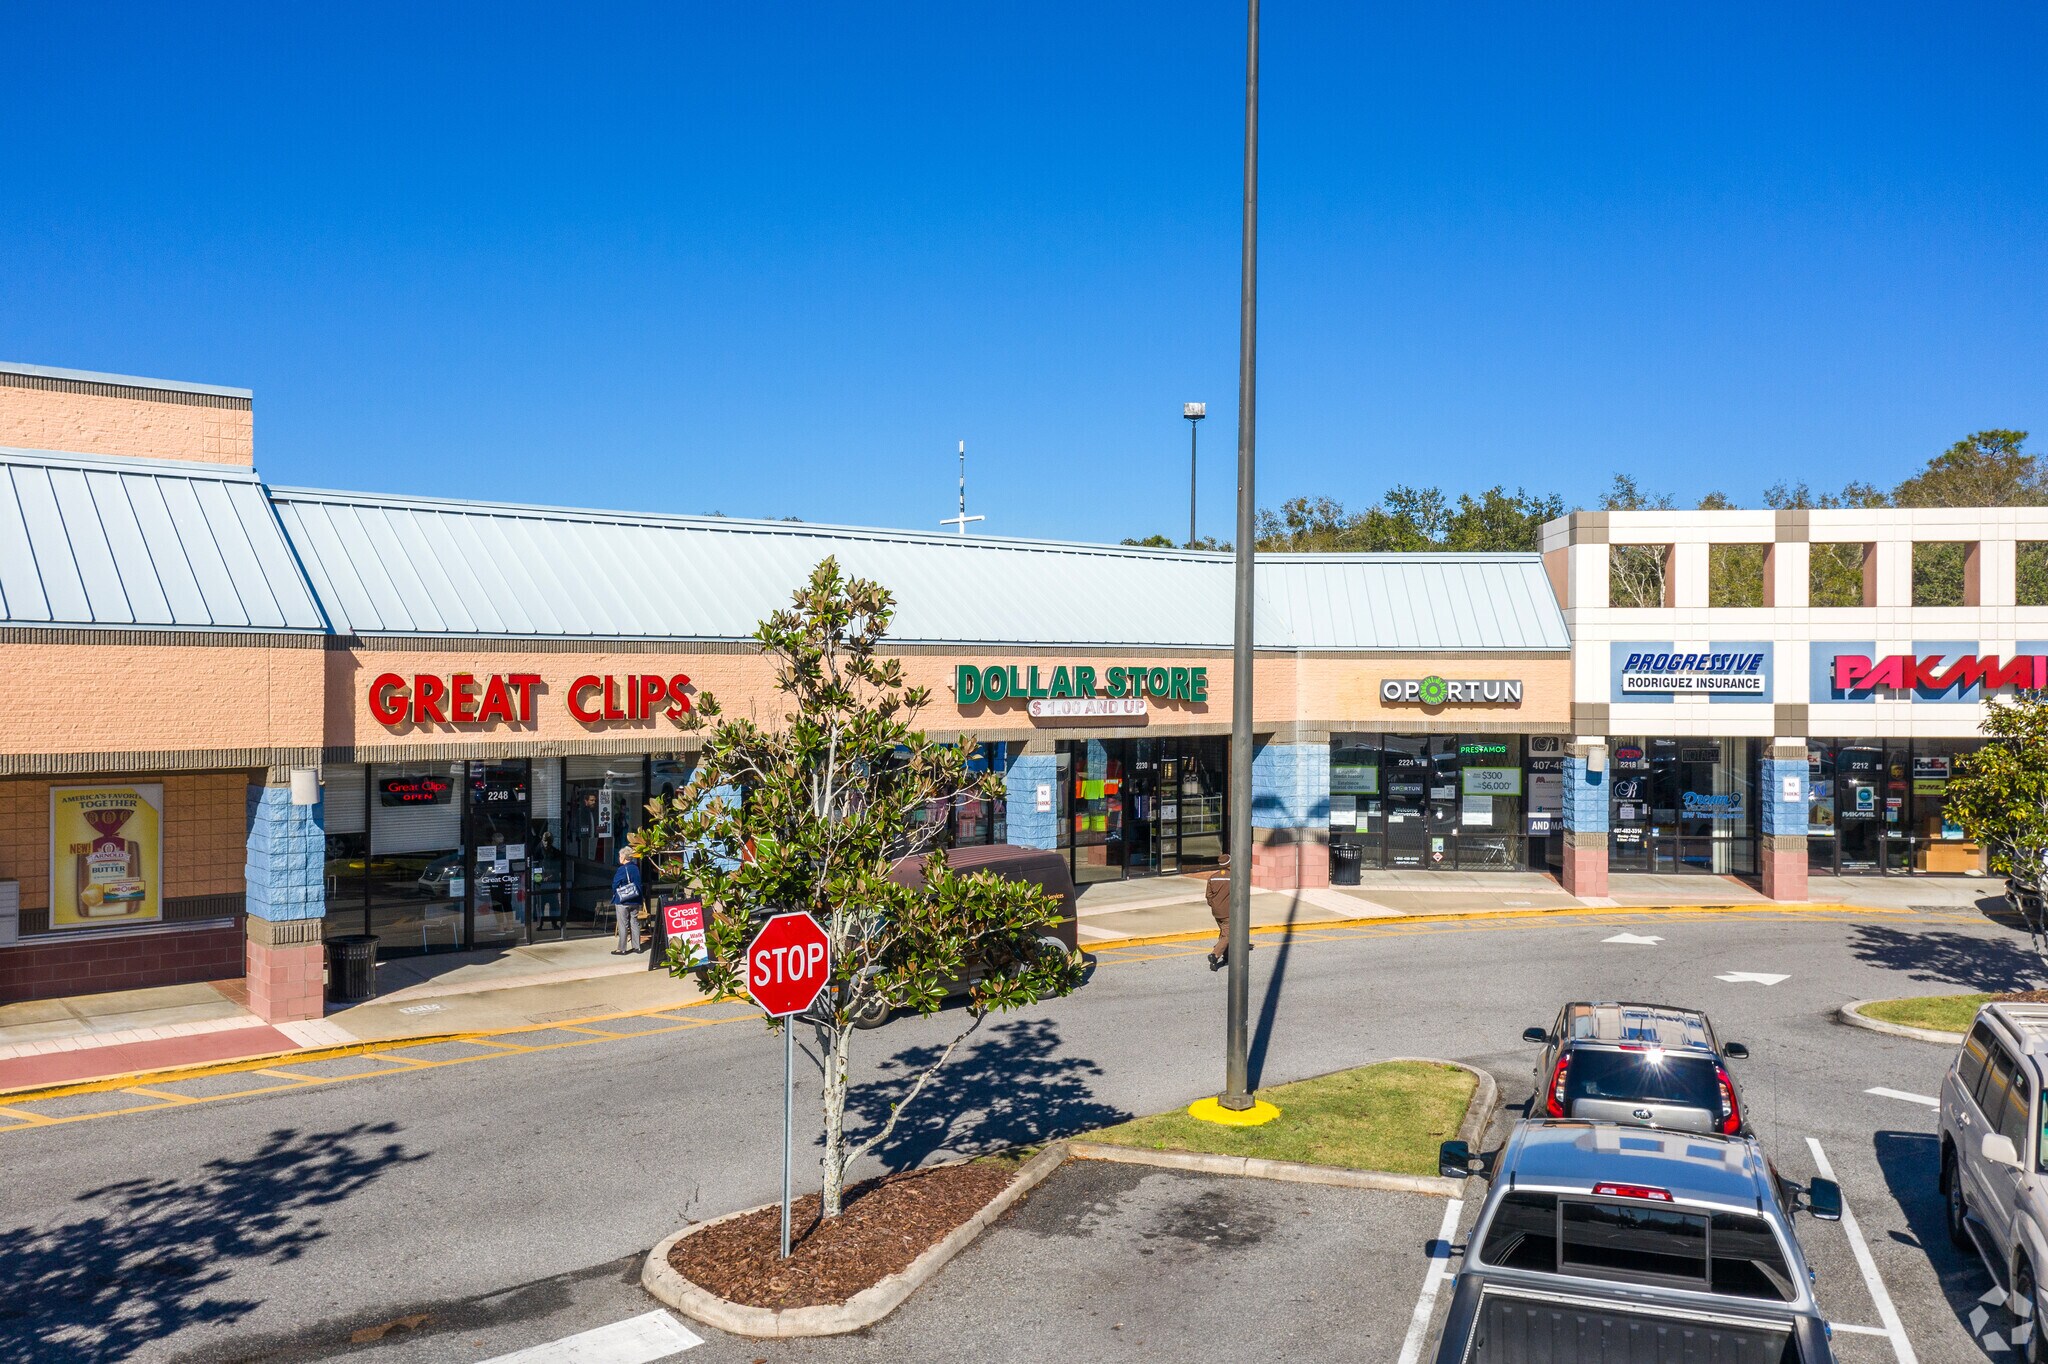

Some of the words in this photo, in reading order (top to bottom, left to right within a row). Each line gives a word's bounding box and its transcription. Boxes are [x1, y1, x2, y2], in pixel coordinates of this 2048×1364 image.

[1624, 653, 1764, 671] PROGRESSIVE
[956, 665, 1097, 704] DOLLAR
[1106, 667, 1207, 702] STORE
[1628, 677, 1692, 688] RODRIGUEZ
[1696, 678, 1760, 689] INSURANCE
[1383, 678, 1521, 702] OPORTUN
[368, 673, 541, 725] GREAT
[565, 674, 692, 722] CLIPS
[1032, 701, 1041, 717] $
[1048, 701, 1081, 715] 1.00
[1085, 700, 1119, 715] AND
[1124, 700, 1145, 714] UP
[1684, 749, 1718, 760] NOTARY
[1914, 759, 1947, 769] FedEx
[1482, 772, 1502, 780] $300
[388, 782, 418, 792] Great
[421, 781, 447, 791] Clips
[62, 793, 106, 803] AMERICA'S
[488, 791, 508, 800] 2248
[1683, 791, 1731, 805] Dream
[80, 800, 137, 808] TOGETHER
[1532, 821, 1549, 830] AND
[70, 843, 91, 854] NEW!
[502, 875, 519, 883] Clips
[668, 907, 698, 918] Great
[672, 917, 698, 929] Clips
[754, 943, 824, 986] STOP
